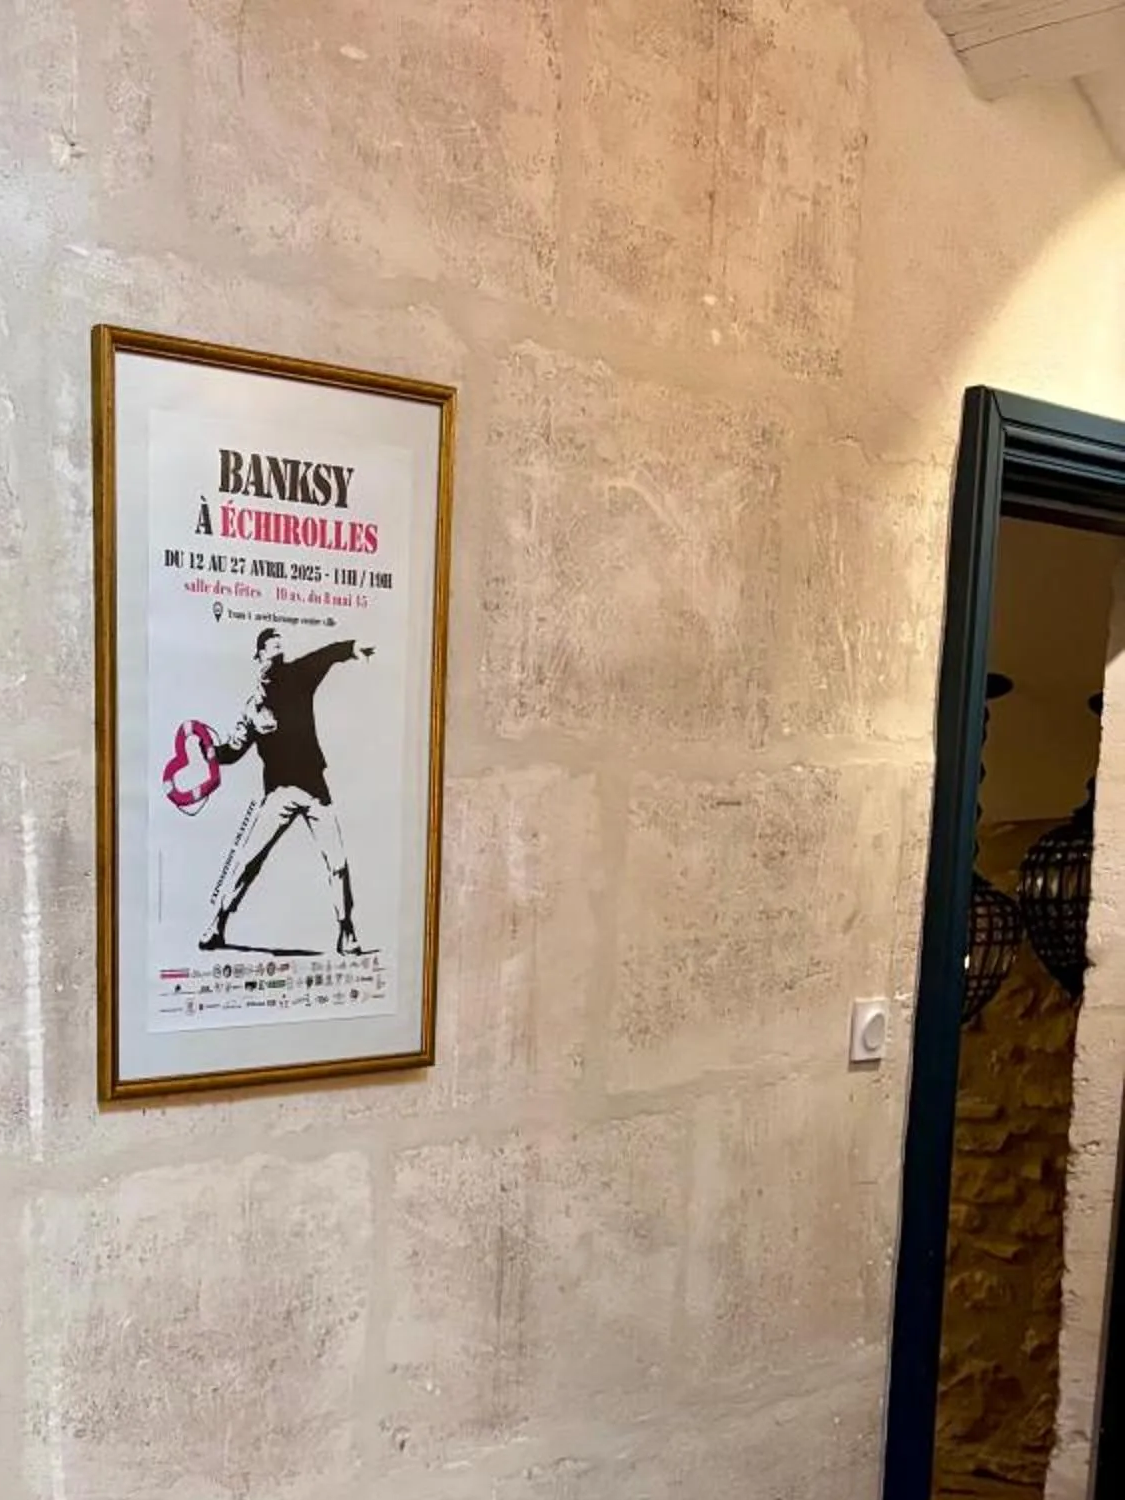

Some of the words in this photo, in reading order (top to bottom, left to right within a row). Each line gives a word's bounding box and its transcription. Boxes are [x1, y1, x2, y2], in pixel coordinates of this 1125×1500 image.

[218, 449, 355, 508] BANKSY
[195, 495, 213, 535] À
[220, 500, 378, 554] ÉCHIROLLES
[164, 549, 184, 568] DU
[189, 552, 204, 570] 12
[209, 554, 227, 572] AU
[231, 557, 246, 574] 27
[251, 559, 287, 579] AVRIL
[290, 563, 322, 582] 2025
[334, 567, 357, 586] 11H
[184, 577, 211, 593] salle
[213, 580, 232, 595] des
